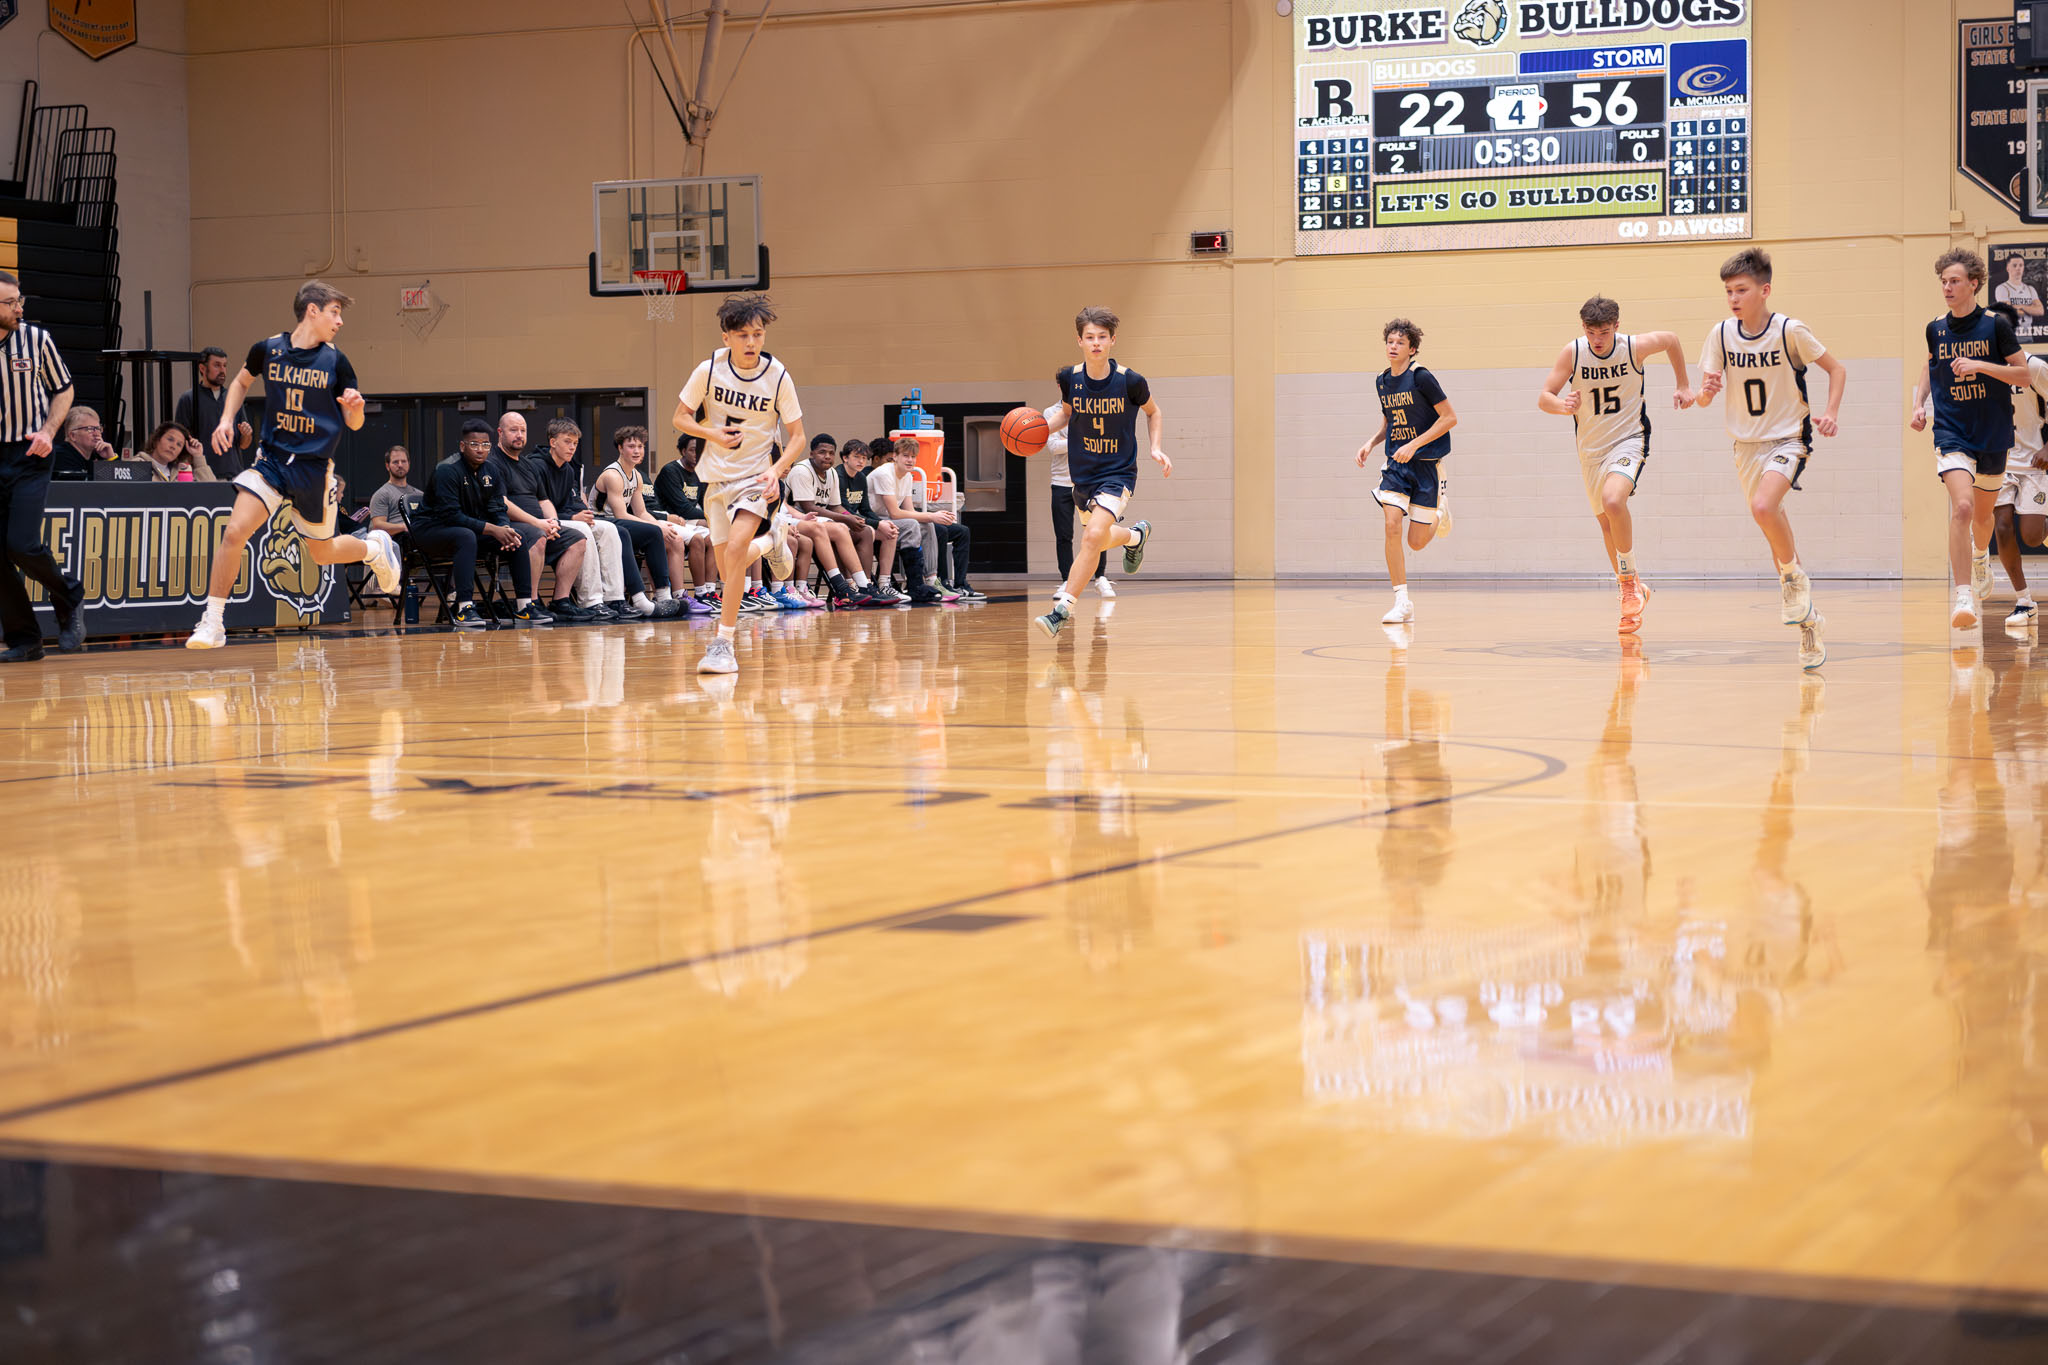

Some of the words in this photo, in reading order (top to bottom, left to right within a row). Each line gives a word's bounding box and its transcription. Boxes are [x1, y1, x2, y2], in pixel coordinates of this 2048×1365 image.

[1519, 0, 1741, 33] BULLDOGS
[1306, 9, 1443, 47] BURKE
[1970, 25, 2005, 47] GIRLS
[1593, 47, 1663, 68] STORM
[1970, 50, 2008, 67] STATE
[1375, 60, 1476, 80] BULLDOGS
[1498, 87, 1536, 97] PERIOD
[1673, 97, 1684, 107] A.
[1686, 94, 1744, 106] MCMAHON
[1508, 99, 1526, 125] 4
[1569, 80, 1638, 127] 56
[1398, 91, 1465, 136] 22
[1970, 109, 2008, 127] STATE
[1620, 129, 1660, 139] FOULS
[1676, 121, 1691, 136] 11
[1707, 121, 1716, 133] 6
[1731, 120, 1741, 132] 0
[1306, 141, 1318, 155] 4
[1332, 141, 1342, 152] 3
[1355, 140, 1364, 151] 4
[1379, 142, 1417, 152] FOULS
[1474, 136, 1560, 165] 05:30
[1632, 142, 1648, 161] 0
[1675, 141, 1693, 155] 14
[1707, 141, 1716, 153] 6
[1731, 140, 1740, 152] 3
[2008, 139, 2043, 155] 197
[1306, 160, 1318, 173] 5
[1332, 160, 1342, 171] 2
[1355, 159, 1364, 170] 0
[1390, 154, 1405, 173] 2
[1673, 159, 1695, 175] 24
[1707, 160, 1716, 172] 4
[1731, 159, 1741, 171] 0
[1303, 178, 1321, 192] 15
[1355, 177, 1364, 189] 1
[1679, 179, 1689, 194] 1
[1707, 179, 1716, 192] 4
[1731, 178, 1740, 190] 3
[1303, 197, 1321, 210] 12
[1332, 197, 1342, 208] 5
[1355, 196, 1364, 207] 1
[1380, 193, 1450, 212] LET'S
[1460, 191, 1498, 209] GO
[1507, 184, 1657, 207] BULLDOGS!
[1673, 198, 1695, 214] 23
[1707, 199, 1716, 211] 4
[1731, 198, 1740, 210] 3
[1302, 216, 1323, 229] 23
[1332, 215, 1342, 226] 4
[1355, 214, 1364, 226] 2
[1618, 220, 1649, 238] GO
[1657, 217, 1745, 236] DAWGS!
[1213, 235, 1222, 249] 2
[405, 290, 424, 305] EXIT
[1727, 350, 1782, 368] BURKE
[1938, 340, 1989, 360] ELKHORN
[268, 363, 329, 390] ELKHORN
[1581, 363, 1628, 380] BURKE
[285, 388, 305, 412] 10
[714, 386, 772, 412] BURKE
[1381, 391, 1414, 409] ELKHORN
[1589, 385, 1621, 415] 15
[1744, 379, 1766, 417] 0
[1950, 383, 1986, 401] SOUTH
[1072, 397, 1125, 414] ELKHORN
[276, 412, 316, 434] SOUTH
[1093, 417, 1105, 436] 4
[1391, 409, 1408, 427] 30
[1390, 426, 1417, 441] SOUTH
[1083, 437, 1119, 454] SOUTH
[114, 467, 132, 480] POSS.
